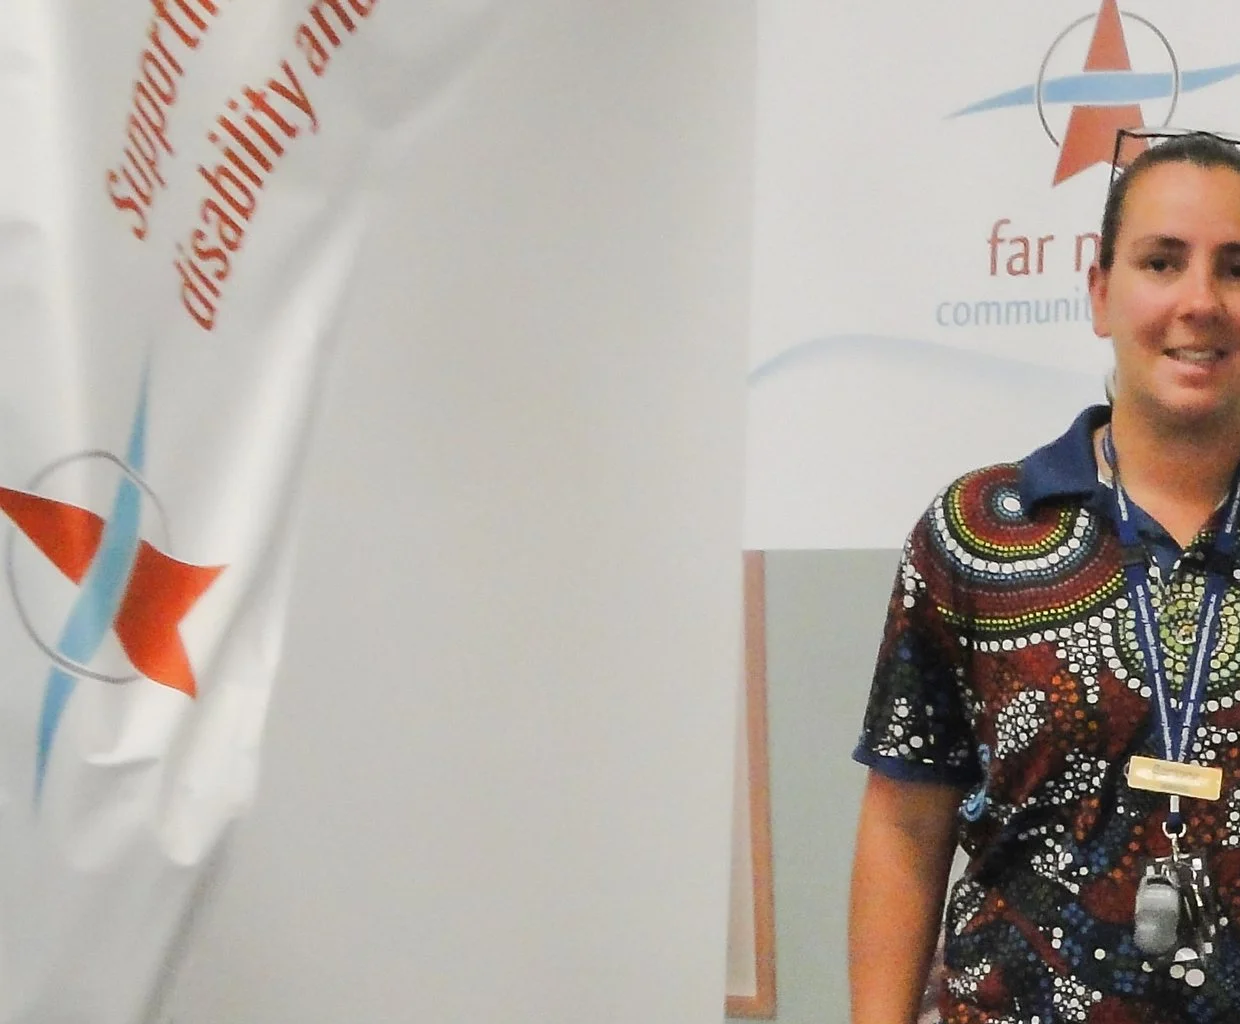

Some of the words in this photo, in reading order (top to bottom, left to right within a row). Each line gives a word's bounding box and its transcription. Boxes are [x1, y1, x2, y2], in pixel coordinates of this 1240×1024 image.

[106, 0, 218, 240] Supporti
[174, 60, 320, 331] disability
[987, 219, 1054, 276] far
[936, 284, 1091, 327] communit
